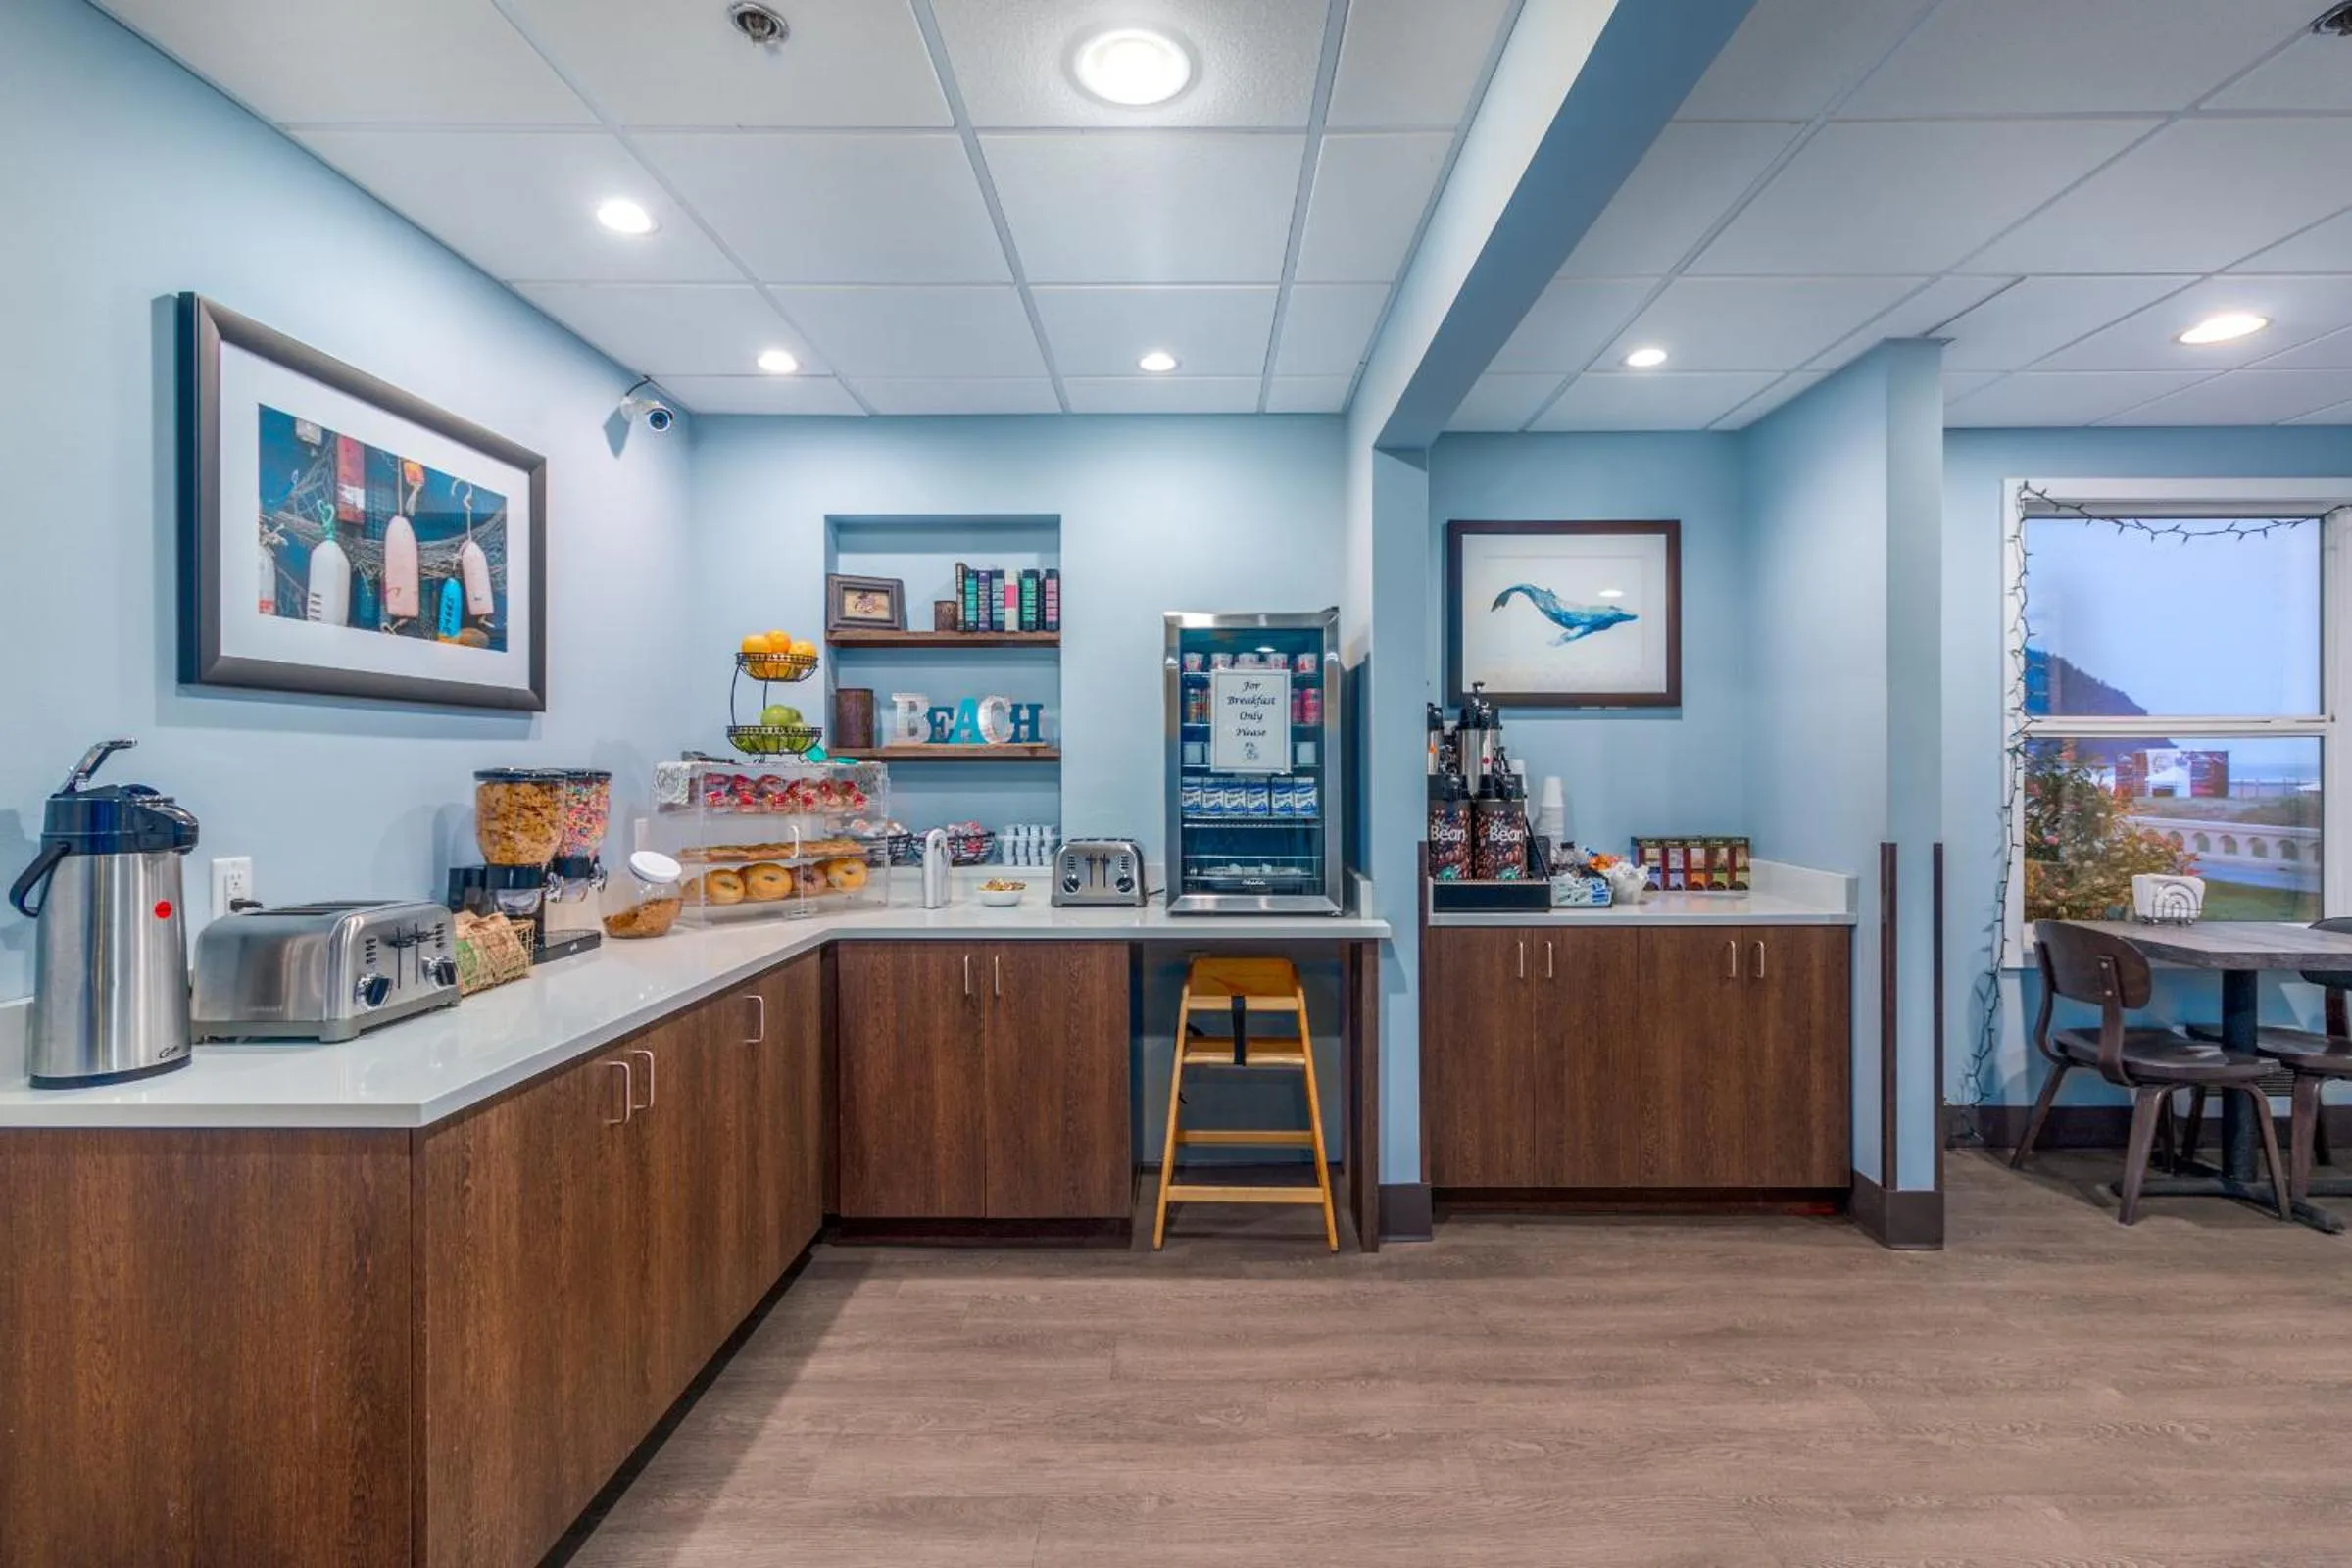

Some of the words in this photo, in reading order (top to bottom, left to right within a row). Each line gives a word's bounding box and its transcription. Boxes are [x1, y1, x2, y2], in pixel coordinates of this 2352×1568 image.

[1242, 681, 1261, 692] For
[1227, 694, 1276, 707] Breakfast
[892, 693, 1044, 744] BEACH
[1239, 711, 1263, 724] Only
[1236, 728, 1266, 737] Please
[1431, 824, 1466, 841] Bean
[1489, 825, 1525, 842] Bean
